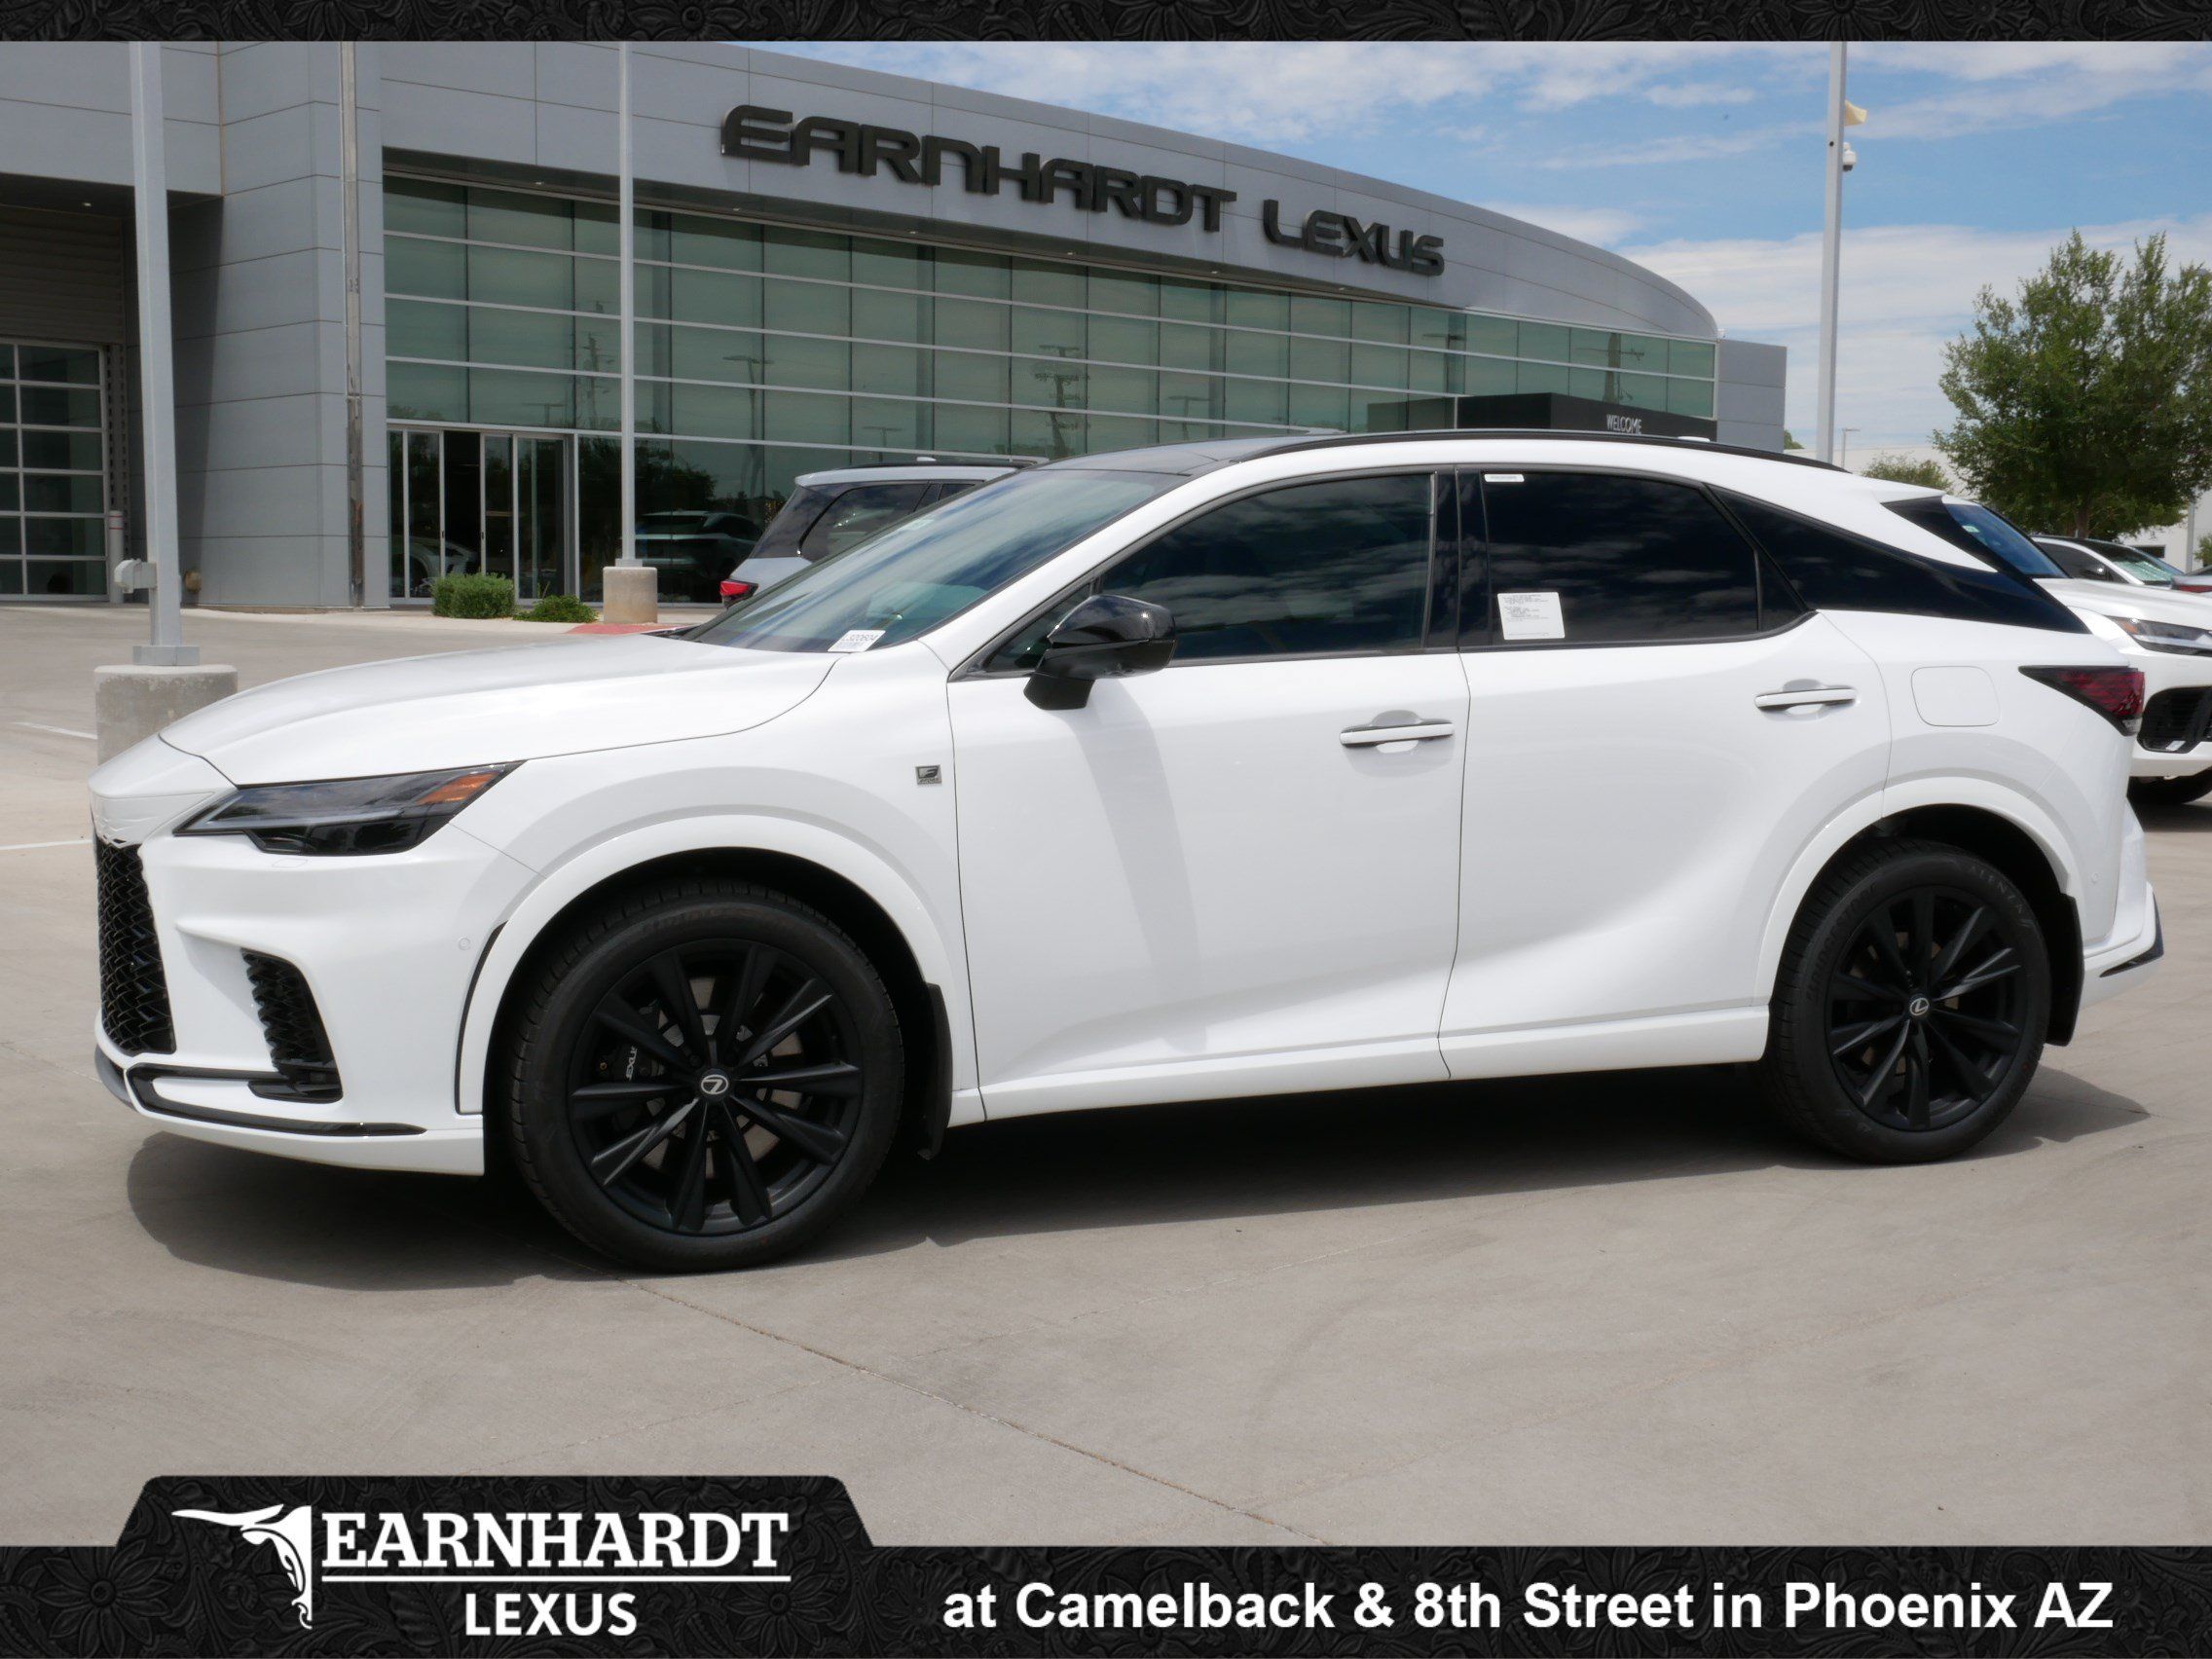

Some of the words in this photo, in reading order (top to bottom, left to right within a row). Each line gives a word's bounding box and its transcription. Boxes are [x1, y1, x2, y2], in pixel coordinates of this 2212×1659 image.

[721, 103, 1237, 233] EARNHARDT
[1263, 198, 1445, 276] LEXUS
[1606, 415, 1642, 434] WELCOME
